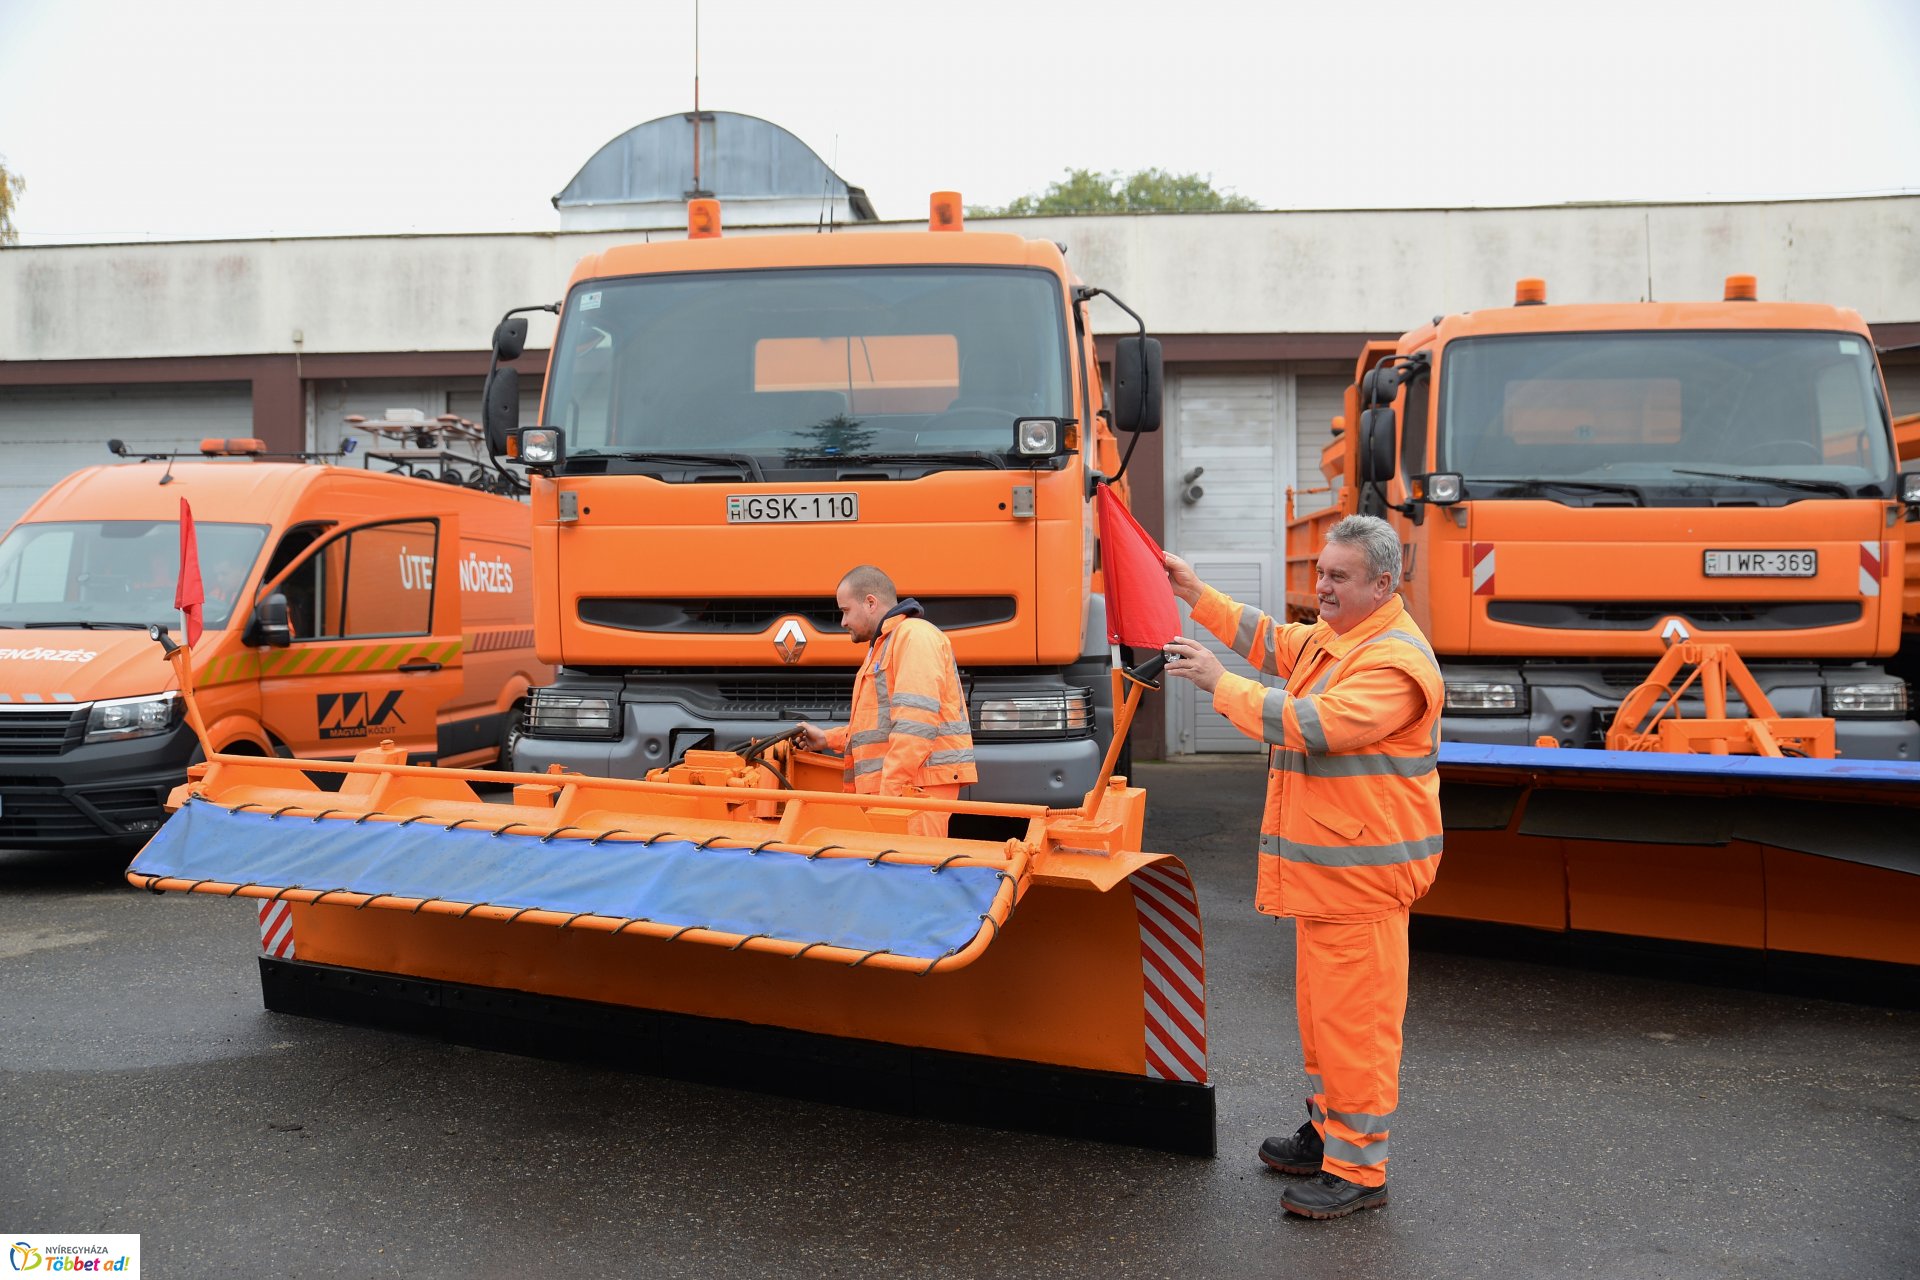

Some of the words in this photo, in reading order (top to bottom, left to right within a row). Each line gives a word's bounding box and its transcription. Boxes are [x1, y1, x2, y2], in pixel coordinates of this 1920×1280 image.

[731, 510, 741, 520] H
[748, 496, 854, 520] GSK-110
[1727, 554, 1812, 572] IWR-369
[329, 728, 366, 738] MAGYAR
